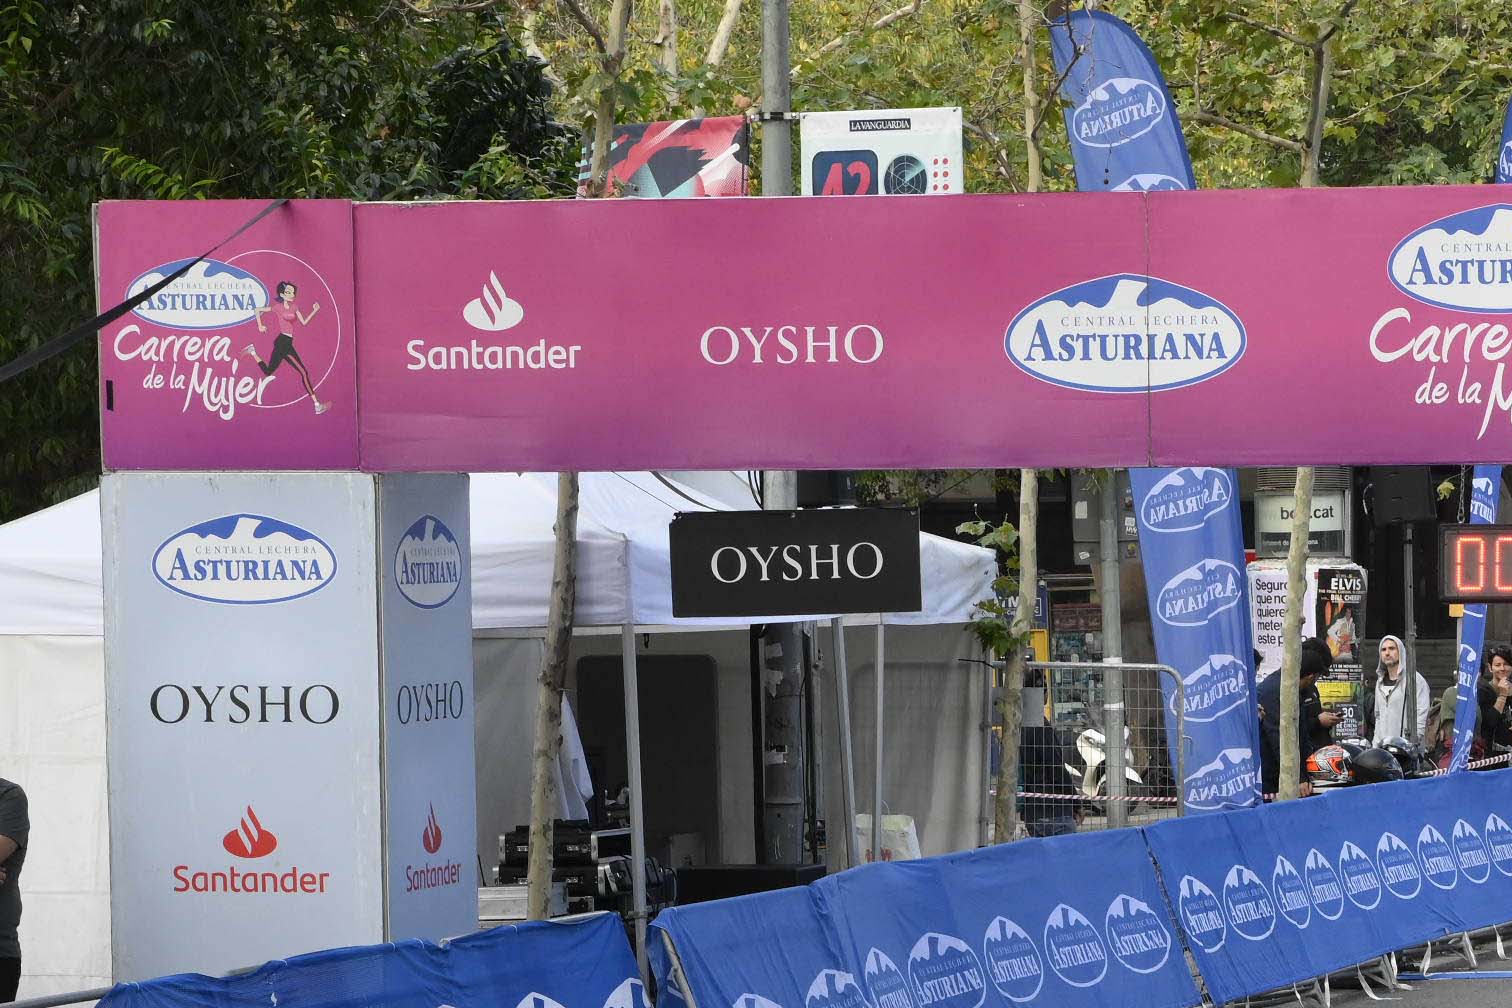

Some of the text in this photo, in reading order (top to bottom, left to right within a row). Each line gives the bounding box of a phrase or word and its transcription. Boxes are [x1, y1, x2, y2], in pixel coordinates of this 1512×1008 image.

[860, 118, 911, 130] VANGUARDIA
[1440, 241, 1510, 254] CENTRAL
[1060, 314, 1219, 327] CENTRAL LECHERA
[113, 324, 232, 362] Carrera
[406, 338, 582, 371] Santander
[700, 323, 885, 366] OYSHO
[1024, 319, 1228, 361] ASTURIANA
[142, 360, 276, 420] de la Mujer
[1414, 365, 1449, 405] de
[1457, 364, 1482, 405] la
[167, 547, 325, 582] ASTURIANA
[195, 544, 318, 556] CENTRAL LECHERA
[710, 542, 885, 584] OYSHO
[399, 555, 459, 586] ASTURIANA
[1331, 577, 1361, 590] ELVIS
[1256, 594, 1273, 606] que
[1257, 619, 1283, 631] mete
[1257, 633, 1276, 644] este
[150, 684, 340, 725] OYSHO
[397, 680, 464, 725] OYSHO
[173, 864, 330, 895] Santander
[405, 859, 462, 894] Santander
[913, 967, 984, 1006] ASTURIANA
